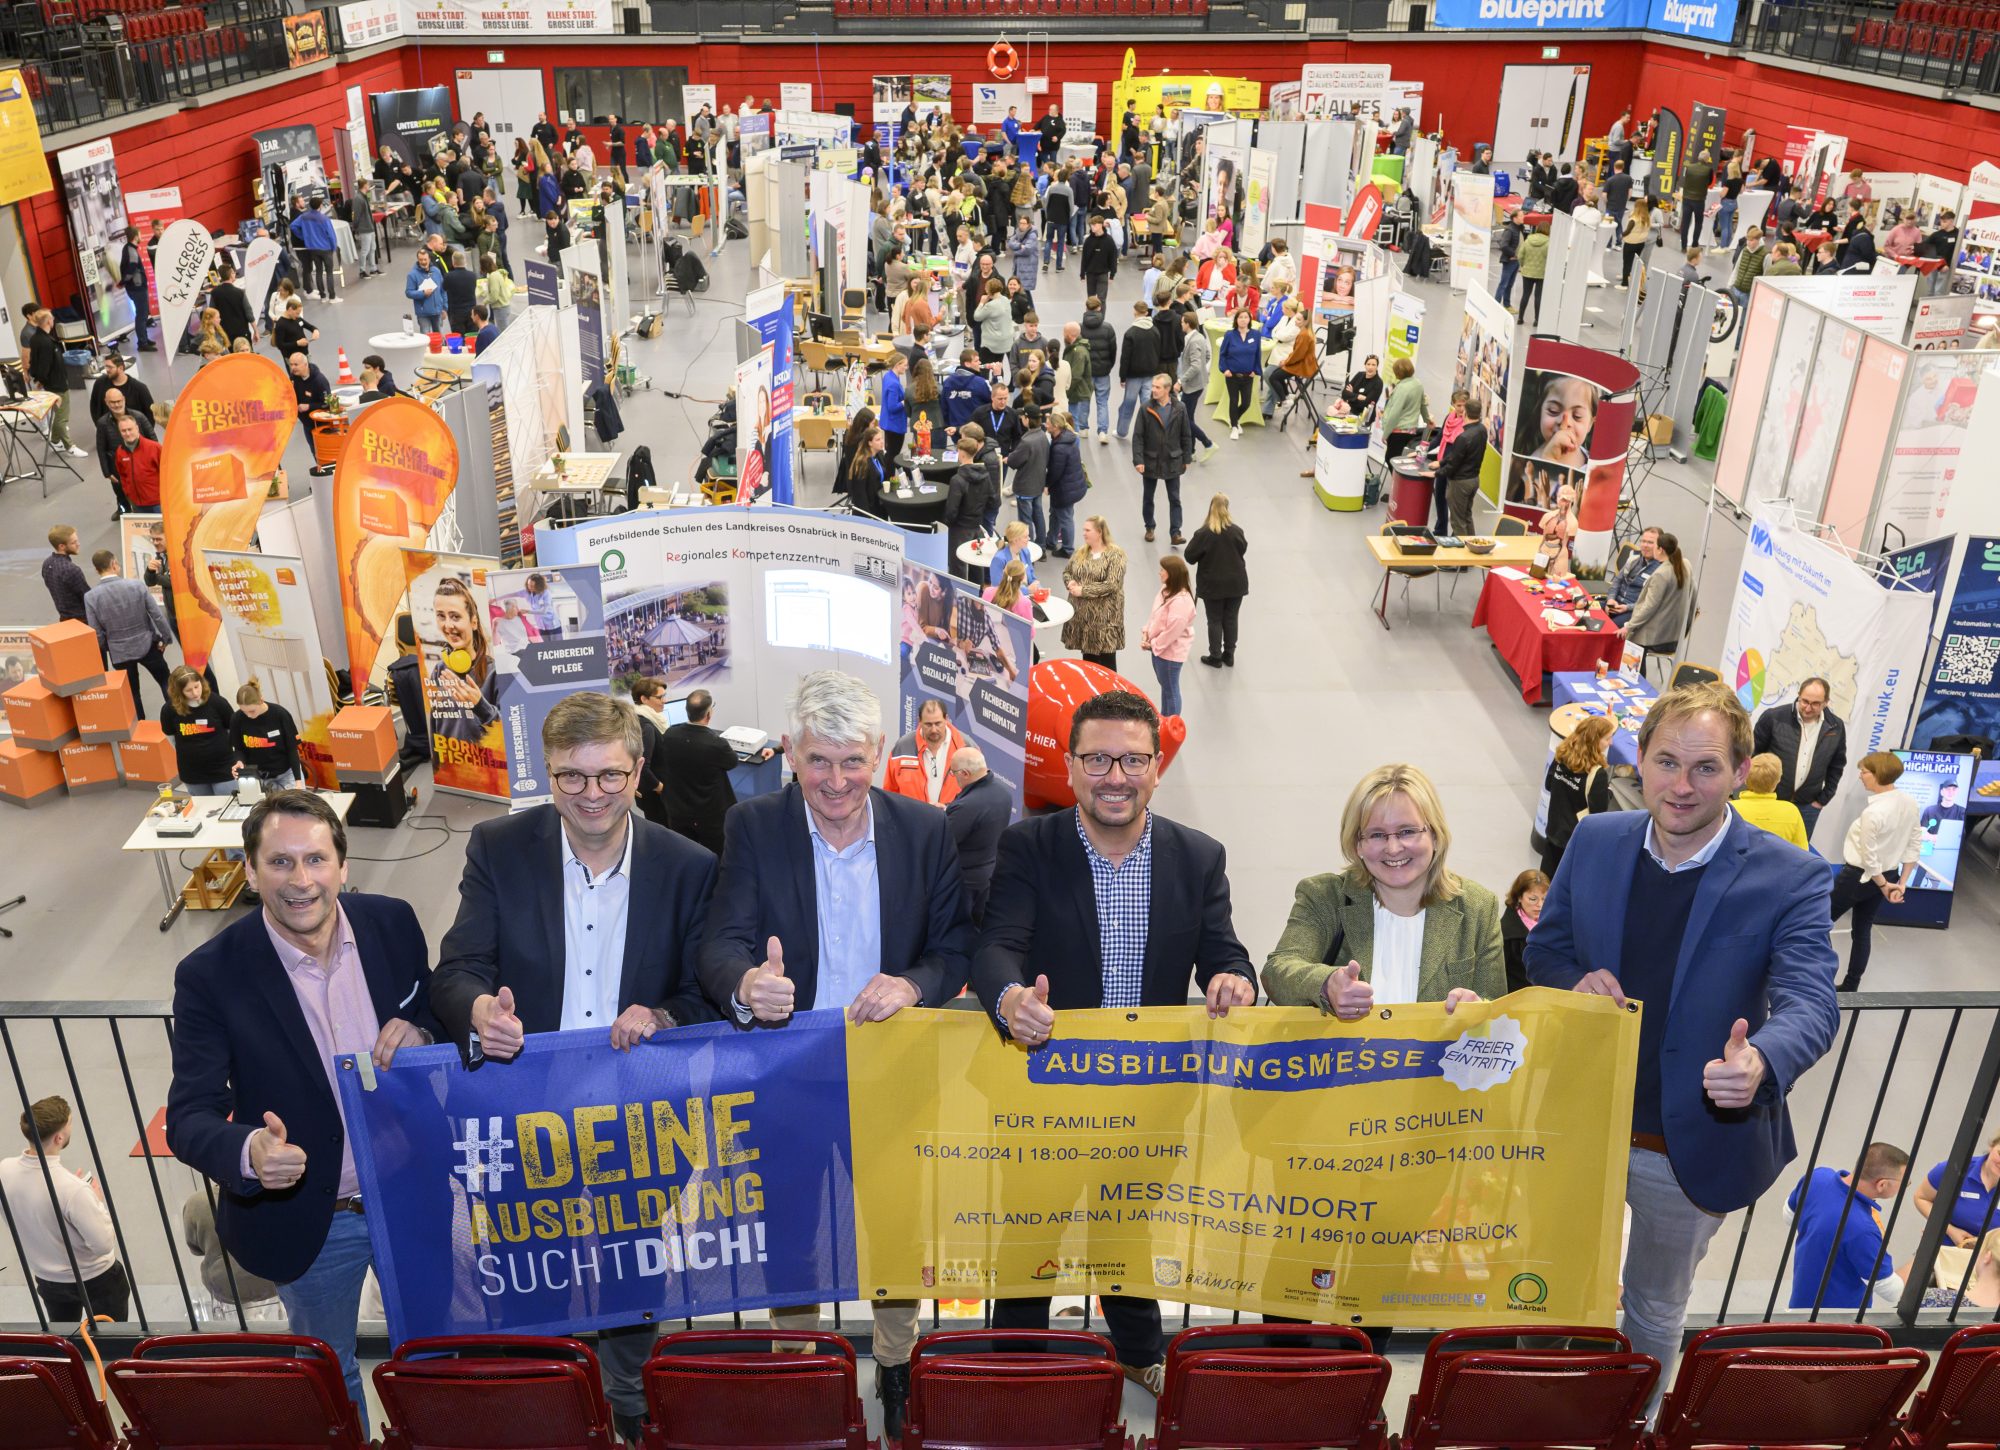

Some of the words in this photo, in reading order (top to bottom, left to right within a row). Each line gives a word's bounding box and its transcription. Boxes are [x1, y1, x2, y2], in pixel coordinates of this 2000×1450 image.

[416, 11, 440, 20] KLEINE
[442, 10, 467, 20] STADT.
[482, 11, 505, 20] KLEINE
[507, 10, 532, 20] STADT.
[547, 11, 570, 20] KLEINE
[572, 10, 597, 20] STADT.
[1480, 0, 1604, 26] blueprint
[1663, 0, 1718, 32] blueprint
[418, 20, 444, 29] GROSSE
[483, 20, 509, 29] GROSSE
[548, 20, 574, 29] GROSSE
[171, 228, 201, 284] LACROIX
[188, 239, 209, 280] KRESS
[589, 526, 660, 547] Berufsbildende
[663, 523, 703, 535] Schulen
[705, 522, 723, 532] des
[726, 522, 785, 533] Landkreises
[788, 524, 838, 539] Osnabrück
[839, 530, 849, 540] in
[850, 532, 900, 552] Bersenbrück
[667, 548, 728, 563] Regionales
[732, 548, 840, 567] Kompetenzzentrum
[1896, 551, 1926, 576] SLA
[214, 570, 227, 580] Du
[1802, 562, 1824, 582] Zukunft
[219, 580, 249, 591] drauf?
[223, 591, 249, 602] Mach
[250, 592, 269, 600] was
[227, 603, 257, 613] draus!
[537, 646, 594, 661] FACHBEREICH
[552, 661, 583, 675] PFLEGE
[424, 678, 438, 688] Du
[75, 692, 109, 702] Tischler
[427, 687, 457, 698] drauf?
[4, 697, 32, 707] Tischler
[430, 699, 455, 709] Mach
[456, 700, 474, 709] was
[981, 689, 1020, 718] FACHBEREICH
[432, 709, 462, 719] draus!
[982, 707, 1017, 734] INFORMATIK
[81, 723, 97, 731] Nord
[509, 705, 525, 760] BERSENBRÜCK
[330, 730, 363, 740] Tischler
[120, 742, 149, 751] Tischler
[1033, 734, 1057, 750] HIER
[64, 744, 98, 755] Tischler
[1913, 753, 1934, 762] MEIN
[1936, 755, 1951, 763] SLA
[1904, 761, 1960, 774] HIGHLIGHT
[71, 776, 87, 784] Nord
[1463, 1040, 1514, 1055] FREIER
[1045, 1050, 1424, 1080] AUSBILDUNGSMESSE
[1445, 1050, 1516, 1074] EINTRITT!
[995, 1115, 1035, 1129] FÜR
[1043, 1115, 1136, 1129] FAMILIEN
[1349, 1119, 1387, 1137] FÜR
[1395, 1109, 1483, 1132] SCHULEN
[453, 1091, 760, 1192] #DEINE
[913, 1144, 1011, 1161] 16.04.2024
[1145, 1145, 1188, 1159] UHR
[1286, 1155, 1383, 1173] 17.04.2024
[1501, 1145, 1545, 1161] UHR
[1100, 1182, 1377, 1221] MESSESTANDORT
[471, 1173, 765, 1244] AUSBILDUNG
[954, 1212, 1042, 1225] ARTLAND
[1047, 1210, 1112, 1223] ARENA
[1127, 1209, 1267, 1236] JAHNSTRASSE
[1273, 1225, 1293, 1239] 21
[1311, 1229, 1365, 1245] 49610
[1371, 1223, 1518, 1245] QUAKENBRÜCK
[1185, 1274, 1257, 1292] BRAMSCHE
[1285, 1287, 1328, 1298] Samtgemeinde
[1381, 1292, 1472, 1305] NEUENKIRCHEN
[1506, 1303, 1547, 1313] MaßArbeit
